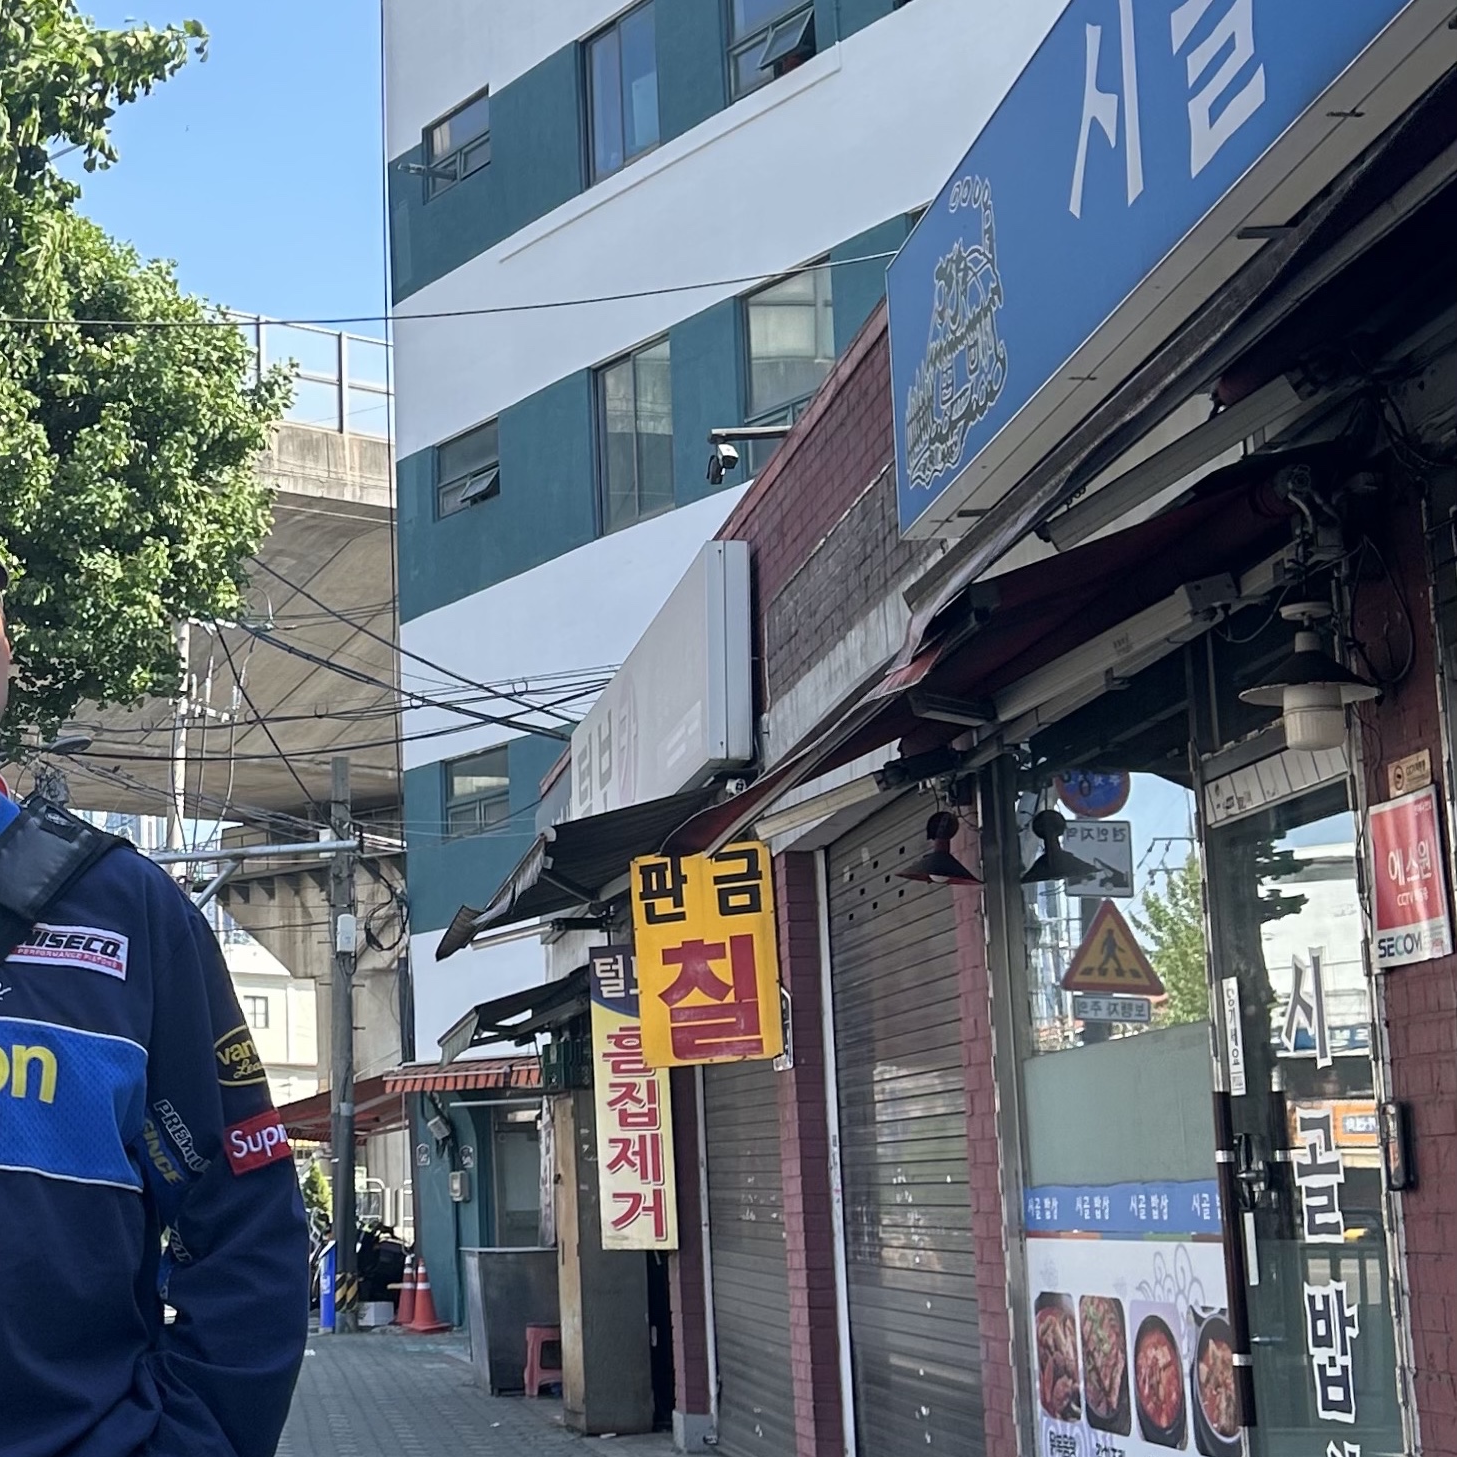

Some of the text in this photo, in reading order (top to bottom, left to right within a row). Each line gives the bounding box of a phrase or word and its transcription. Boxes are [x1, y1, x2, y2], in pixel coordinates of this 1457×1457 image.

[638, 848, 764, 926] 판금
[1387, 840, 1432, 887] 에스원
[17, 948, 83, 961] PERFORMANCE
[657, 934, 764, 1062] 칠
[601, 1026, 669, 1242] 흠집제거
[1129, 1194, 1147, 1220] 시골
[1150, 1194, 1169, 1220] 밥상
[1191, 1193, 1211, 1220] 시골
